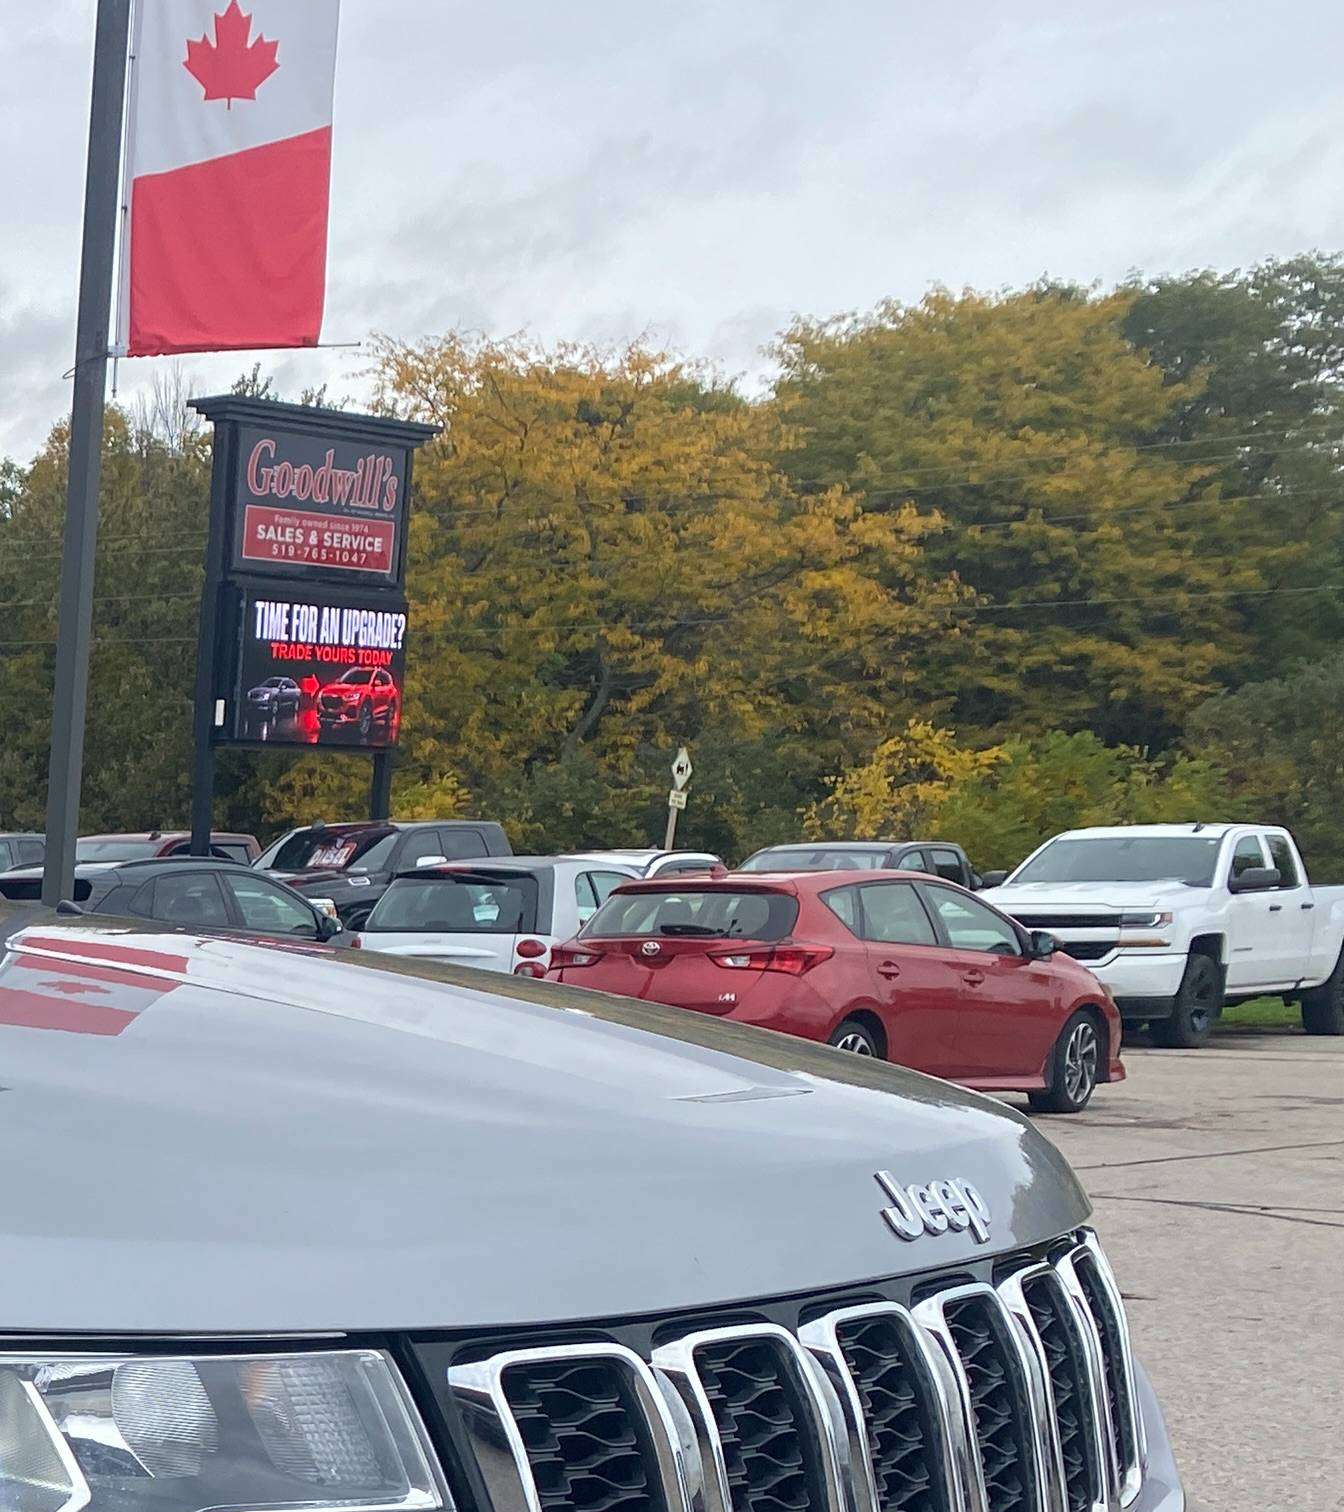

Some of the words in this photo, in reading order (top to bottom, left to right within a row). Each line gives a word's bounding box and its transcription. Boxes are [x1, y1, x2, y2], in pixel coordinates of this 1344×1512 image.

[247, 439, 398, 511] Goodwill's
[257, 525, 304, 544] SALES
[309, 530, 318, 545] &
[323, 532, 383, 552] SERVICE
[274, 514, 300, 526] Family
[255, 601, 290, 641] TIME
[291, 603, 319, 643] FOR
[320, 606, 341, 645] AN
[342, 608, 406, 650] UPGRADE?
[271, 642, 314, 660] TRADE
[314, 645, 356, 664] YOURS
[357, 649, 393, 666] TODAY
[873, 1170, 992, 1244] Jeep
